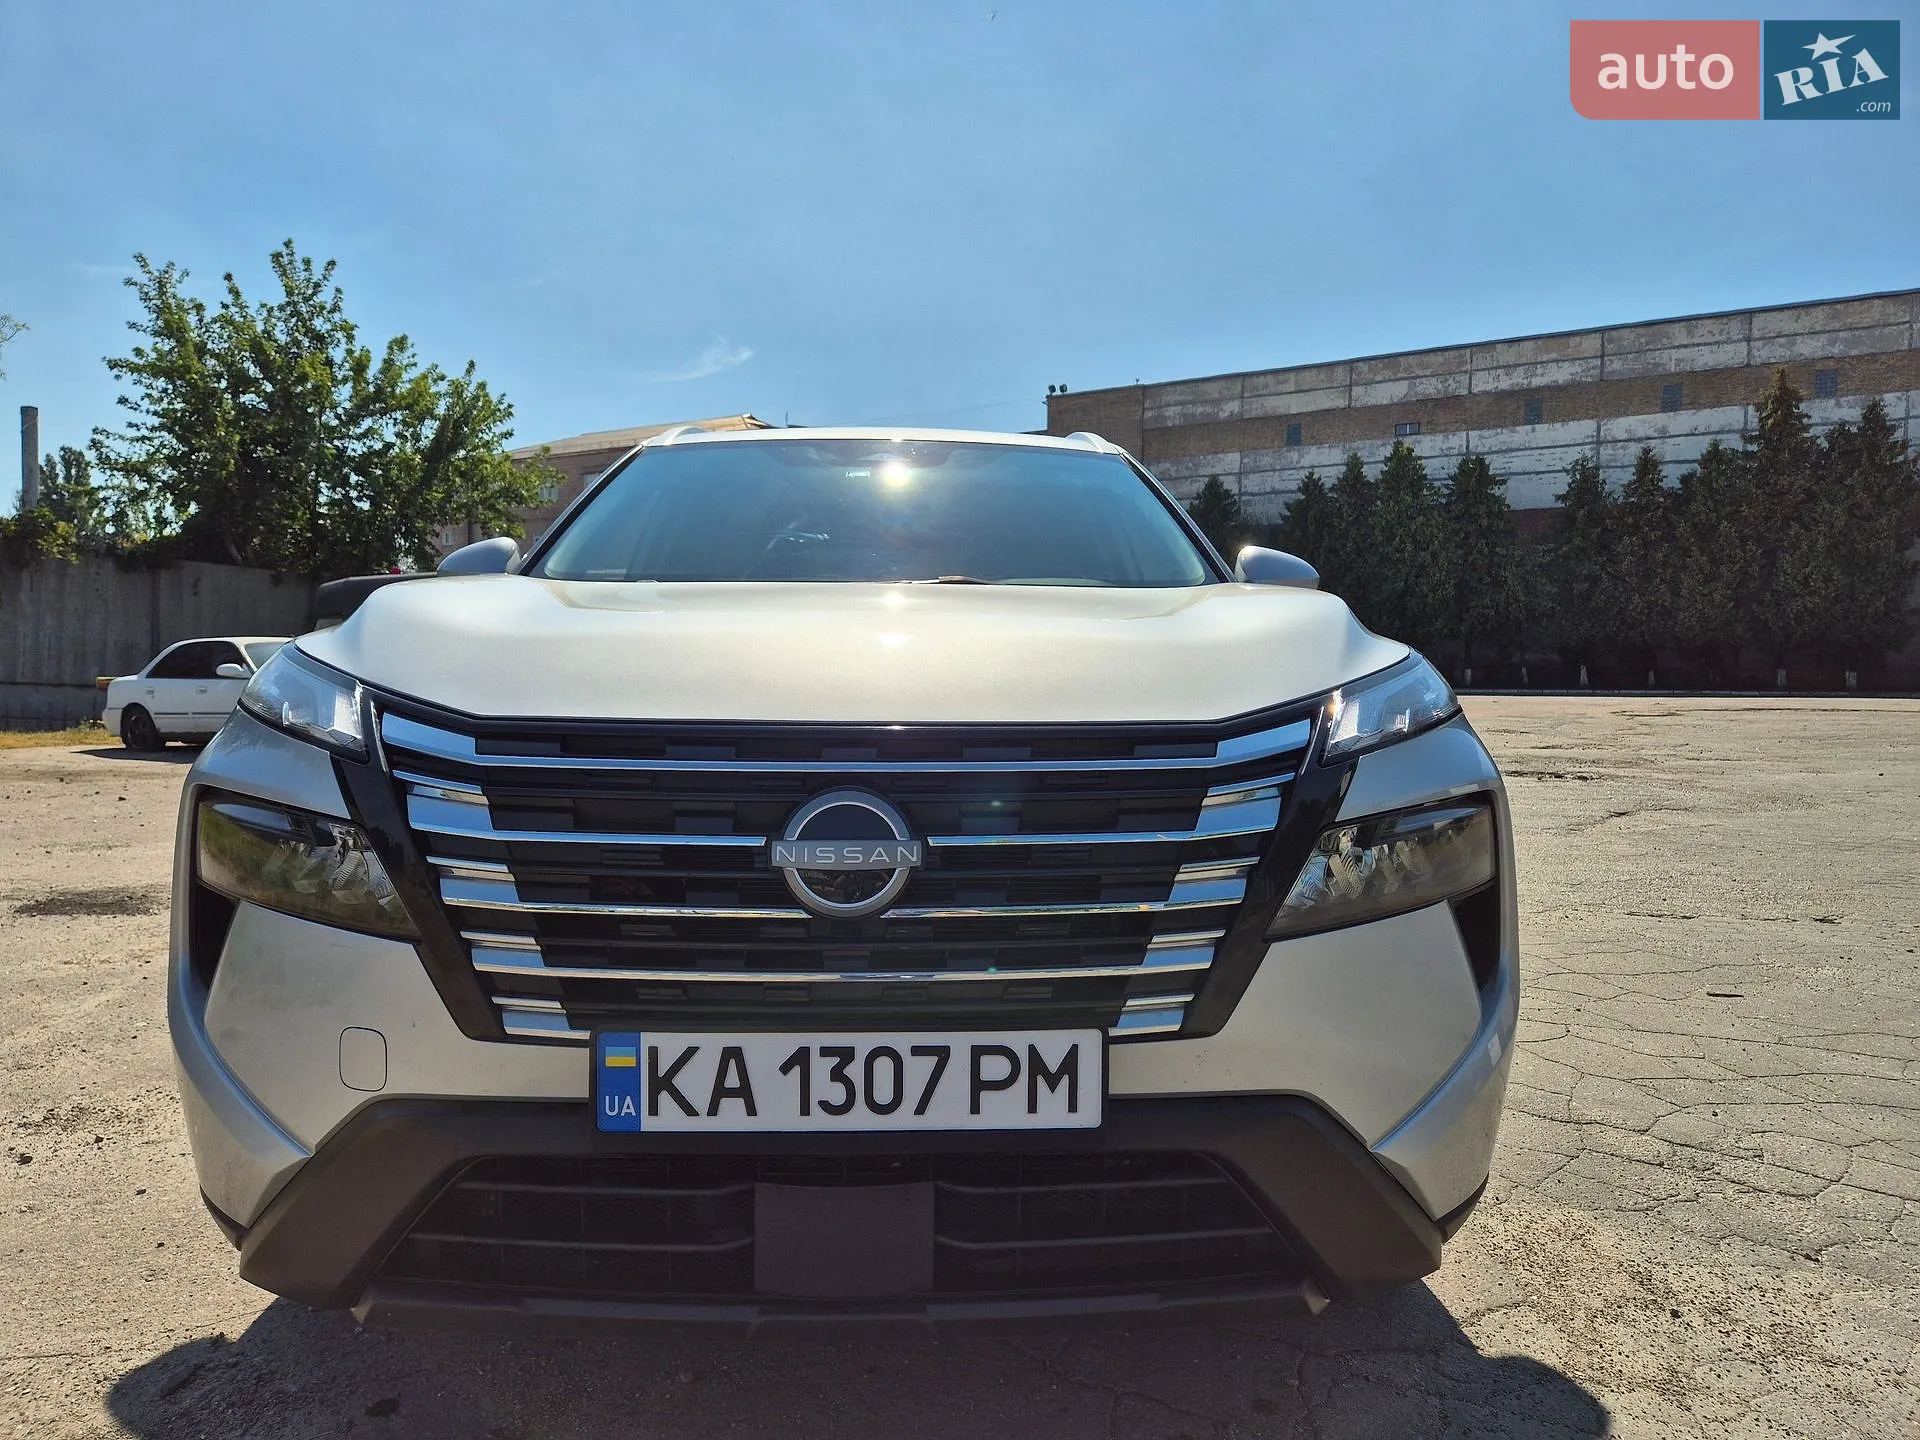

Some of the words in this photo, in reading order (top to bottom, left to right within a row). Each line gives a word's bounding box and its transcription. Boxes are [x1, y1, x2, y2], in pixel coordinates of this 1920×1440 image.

[776, 845, 917, 863] NISSAN
[648, 1045, 757, 1117] KA
[778, 1045, 951, 1116] 1307
[970, 1043, 1079, 1115] PM
[605, 1095, 636, 1117] UA
